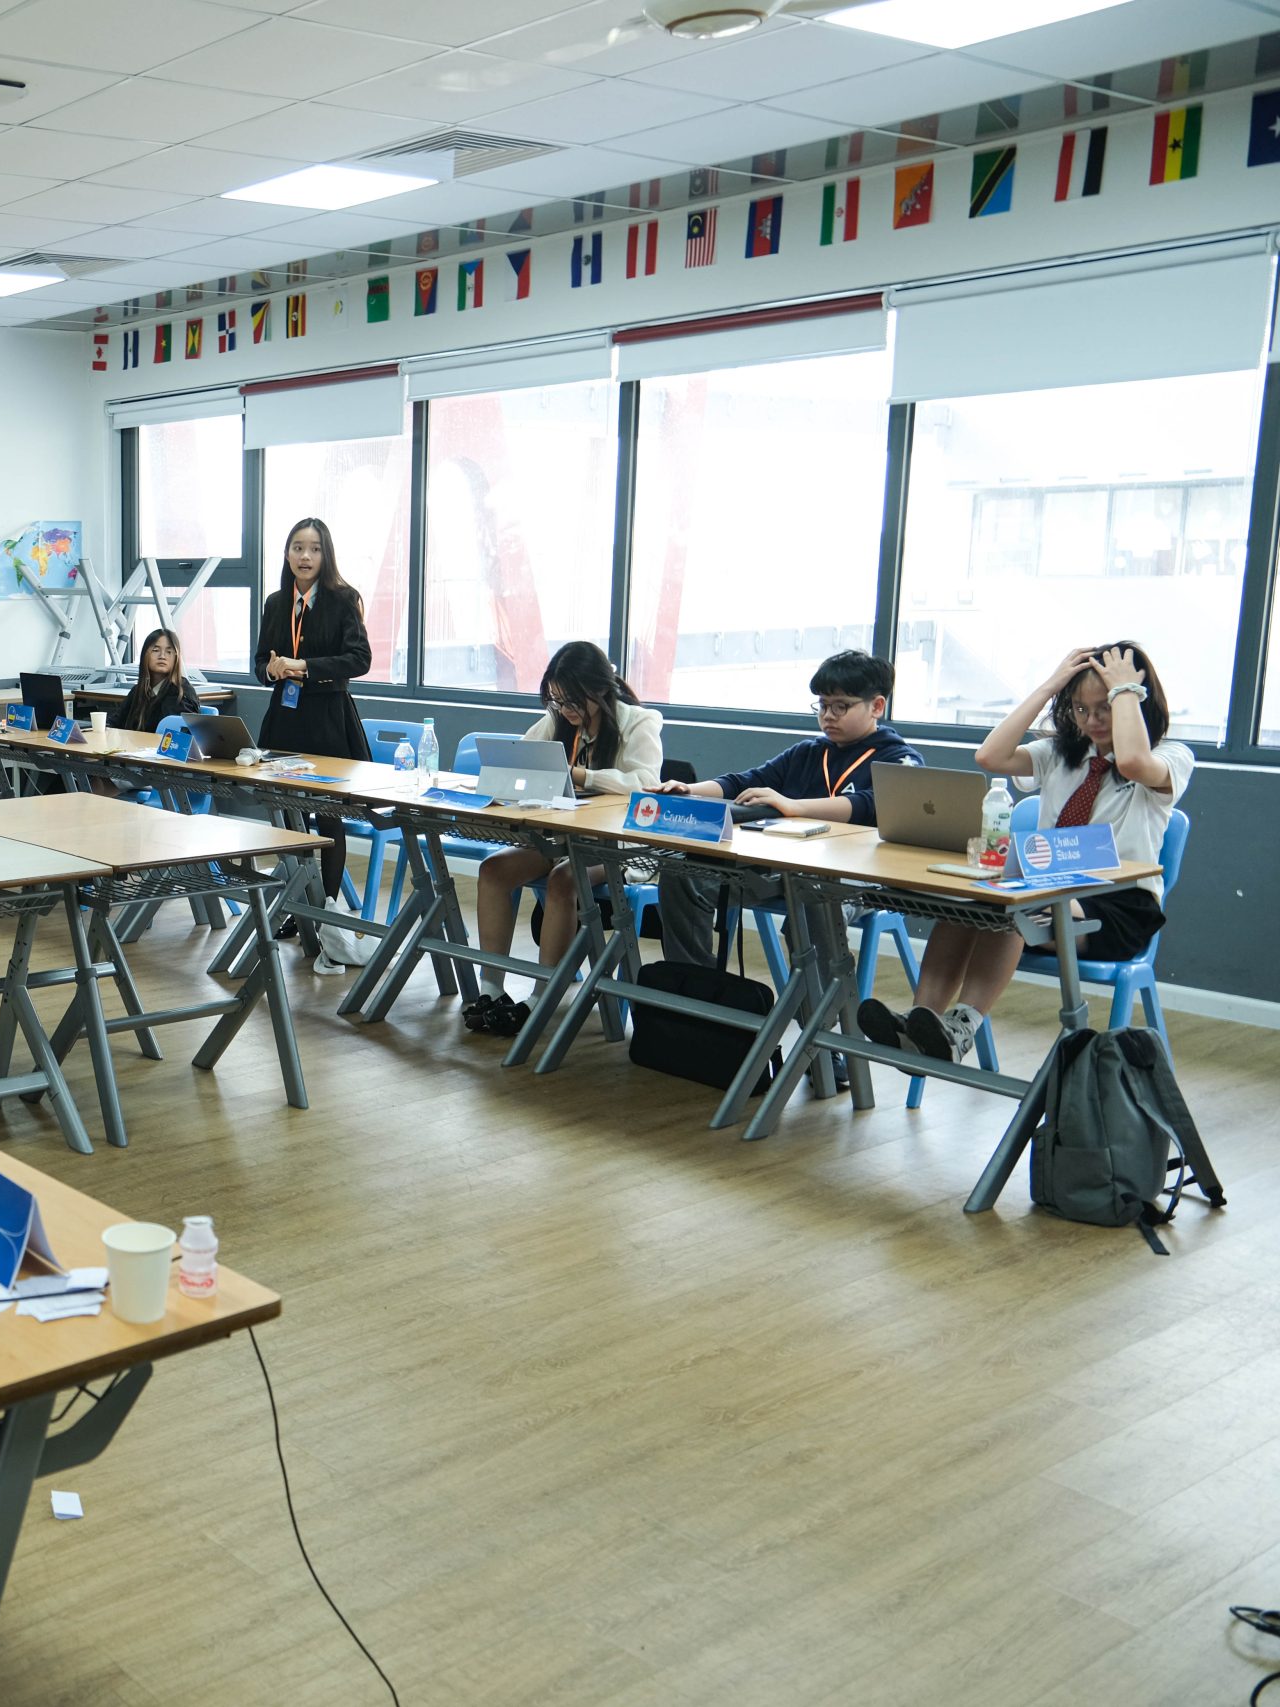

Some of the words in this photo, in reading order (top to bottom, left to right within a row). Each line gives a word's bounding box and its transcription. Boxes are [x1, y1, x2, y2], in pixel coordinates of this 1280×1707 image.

[663, 810, 697, 825] Canada
[1053, 836, 1079, 848] United
[1056, 850, 1081, 861] States
